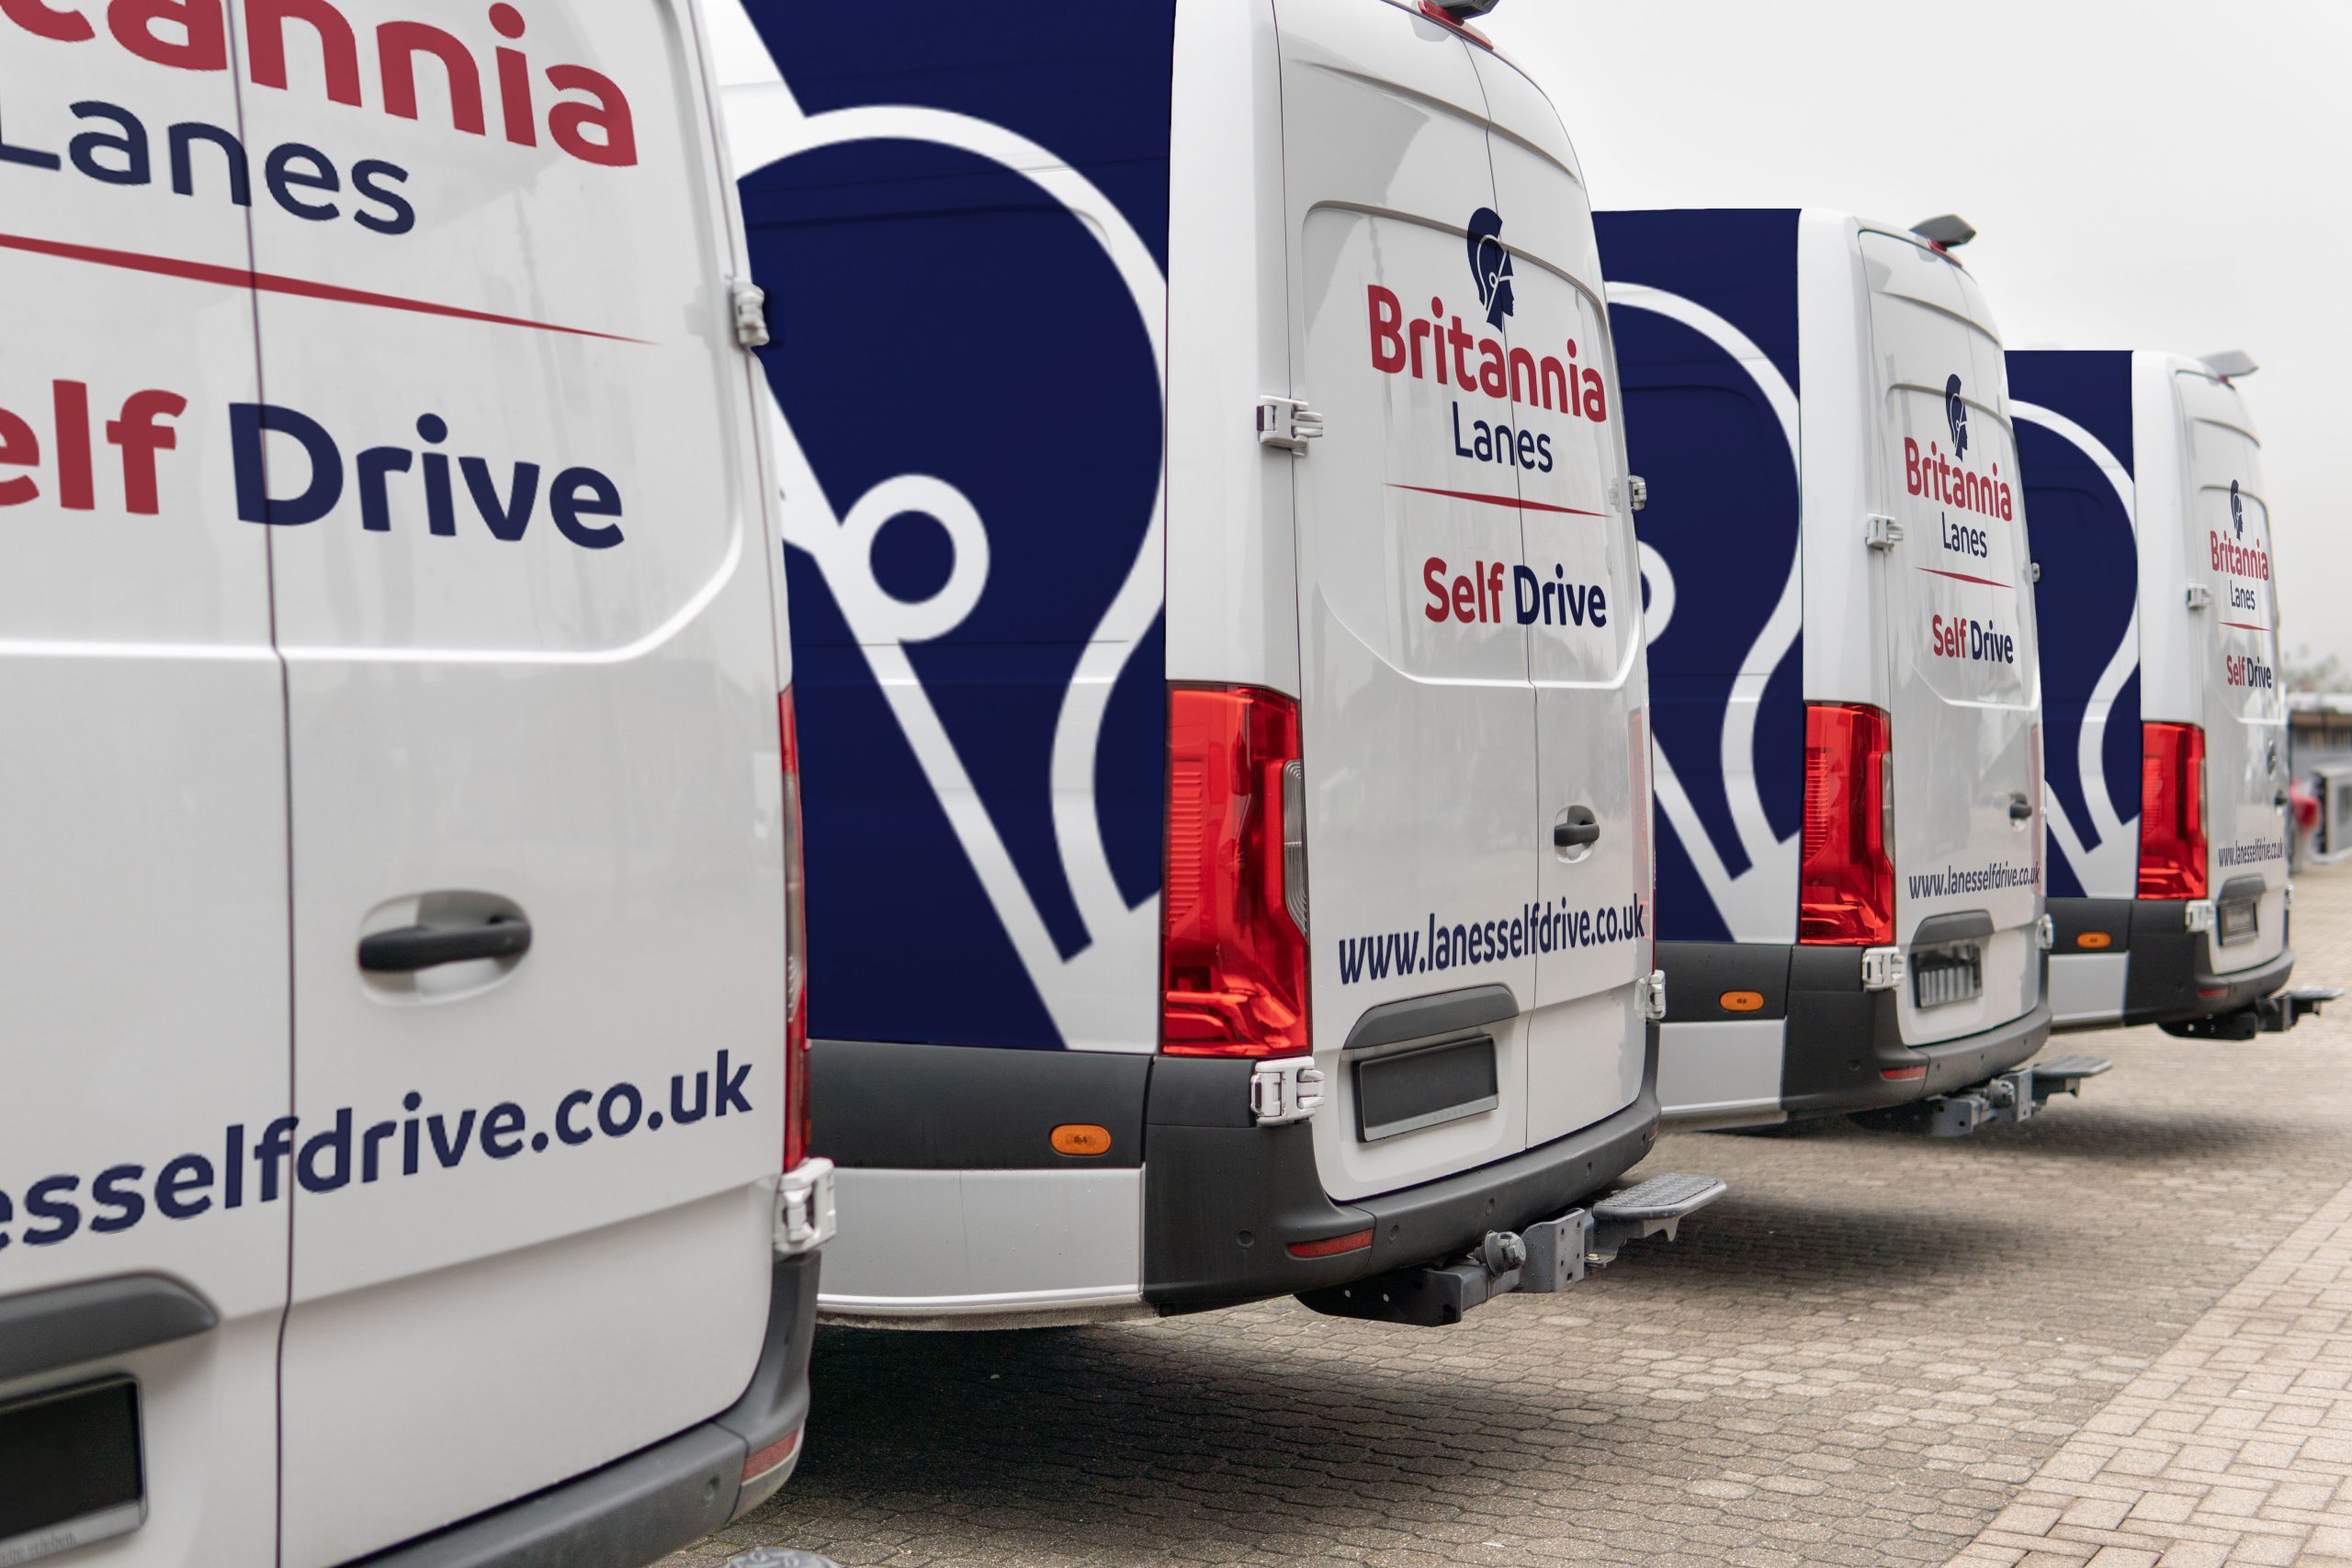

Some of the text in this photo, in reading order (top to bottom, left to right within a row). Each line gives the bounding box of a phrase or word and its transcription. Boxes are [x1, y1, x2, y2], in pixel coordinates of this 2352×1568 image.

[0, 0, 639, 167] annia
[1367, 284, 1607, 423] Britannia
[1452, 400, 1554, 473] Lanes
[228, 402, 625, 550] Drive
[1904, 436, 2013, 522] Britannia
[1941, 511, 1988, 558] Lanes
[2210, 530, 2269, 581] Britannia
[1423, 557, 1607, 628] Self Drive
[2230, 580, 2256, 611] Lanes
[1932, 614, 2014, 664] Self Drive
[2226, 655, 2272, 689] Self Drive
[1908, 860, 2041, 899] www.lanesselfdrive.co.uk
[2218, 836, 2284, 868] www.lanesselfdrive.co.uk
[1339, 893, 1645, 985] www.lanesselfdrive.co.uk
[0, 1049, 753, 1251] sselfdrive.co.uk
